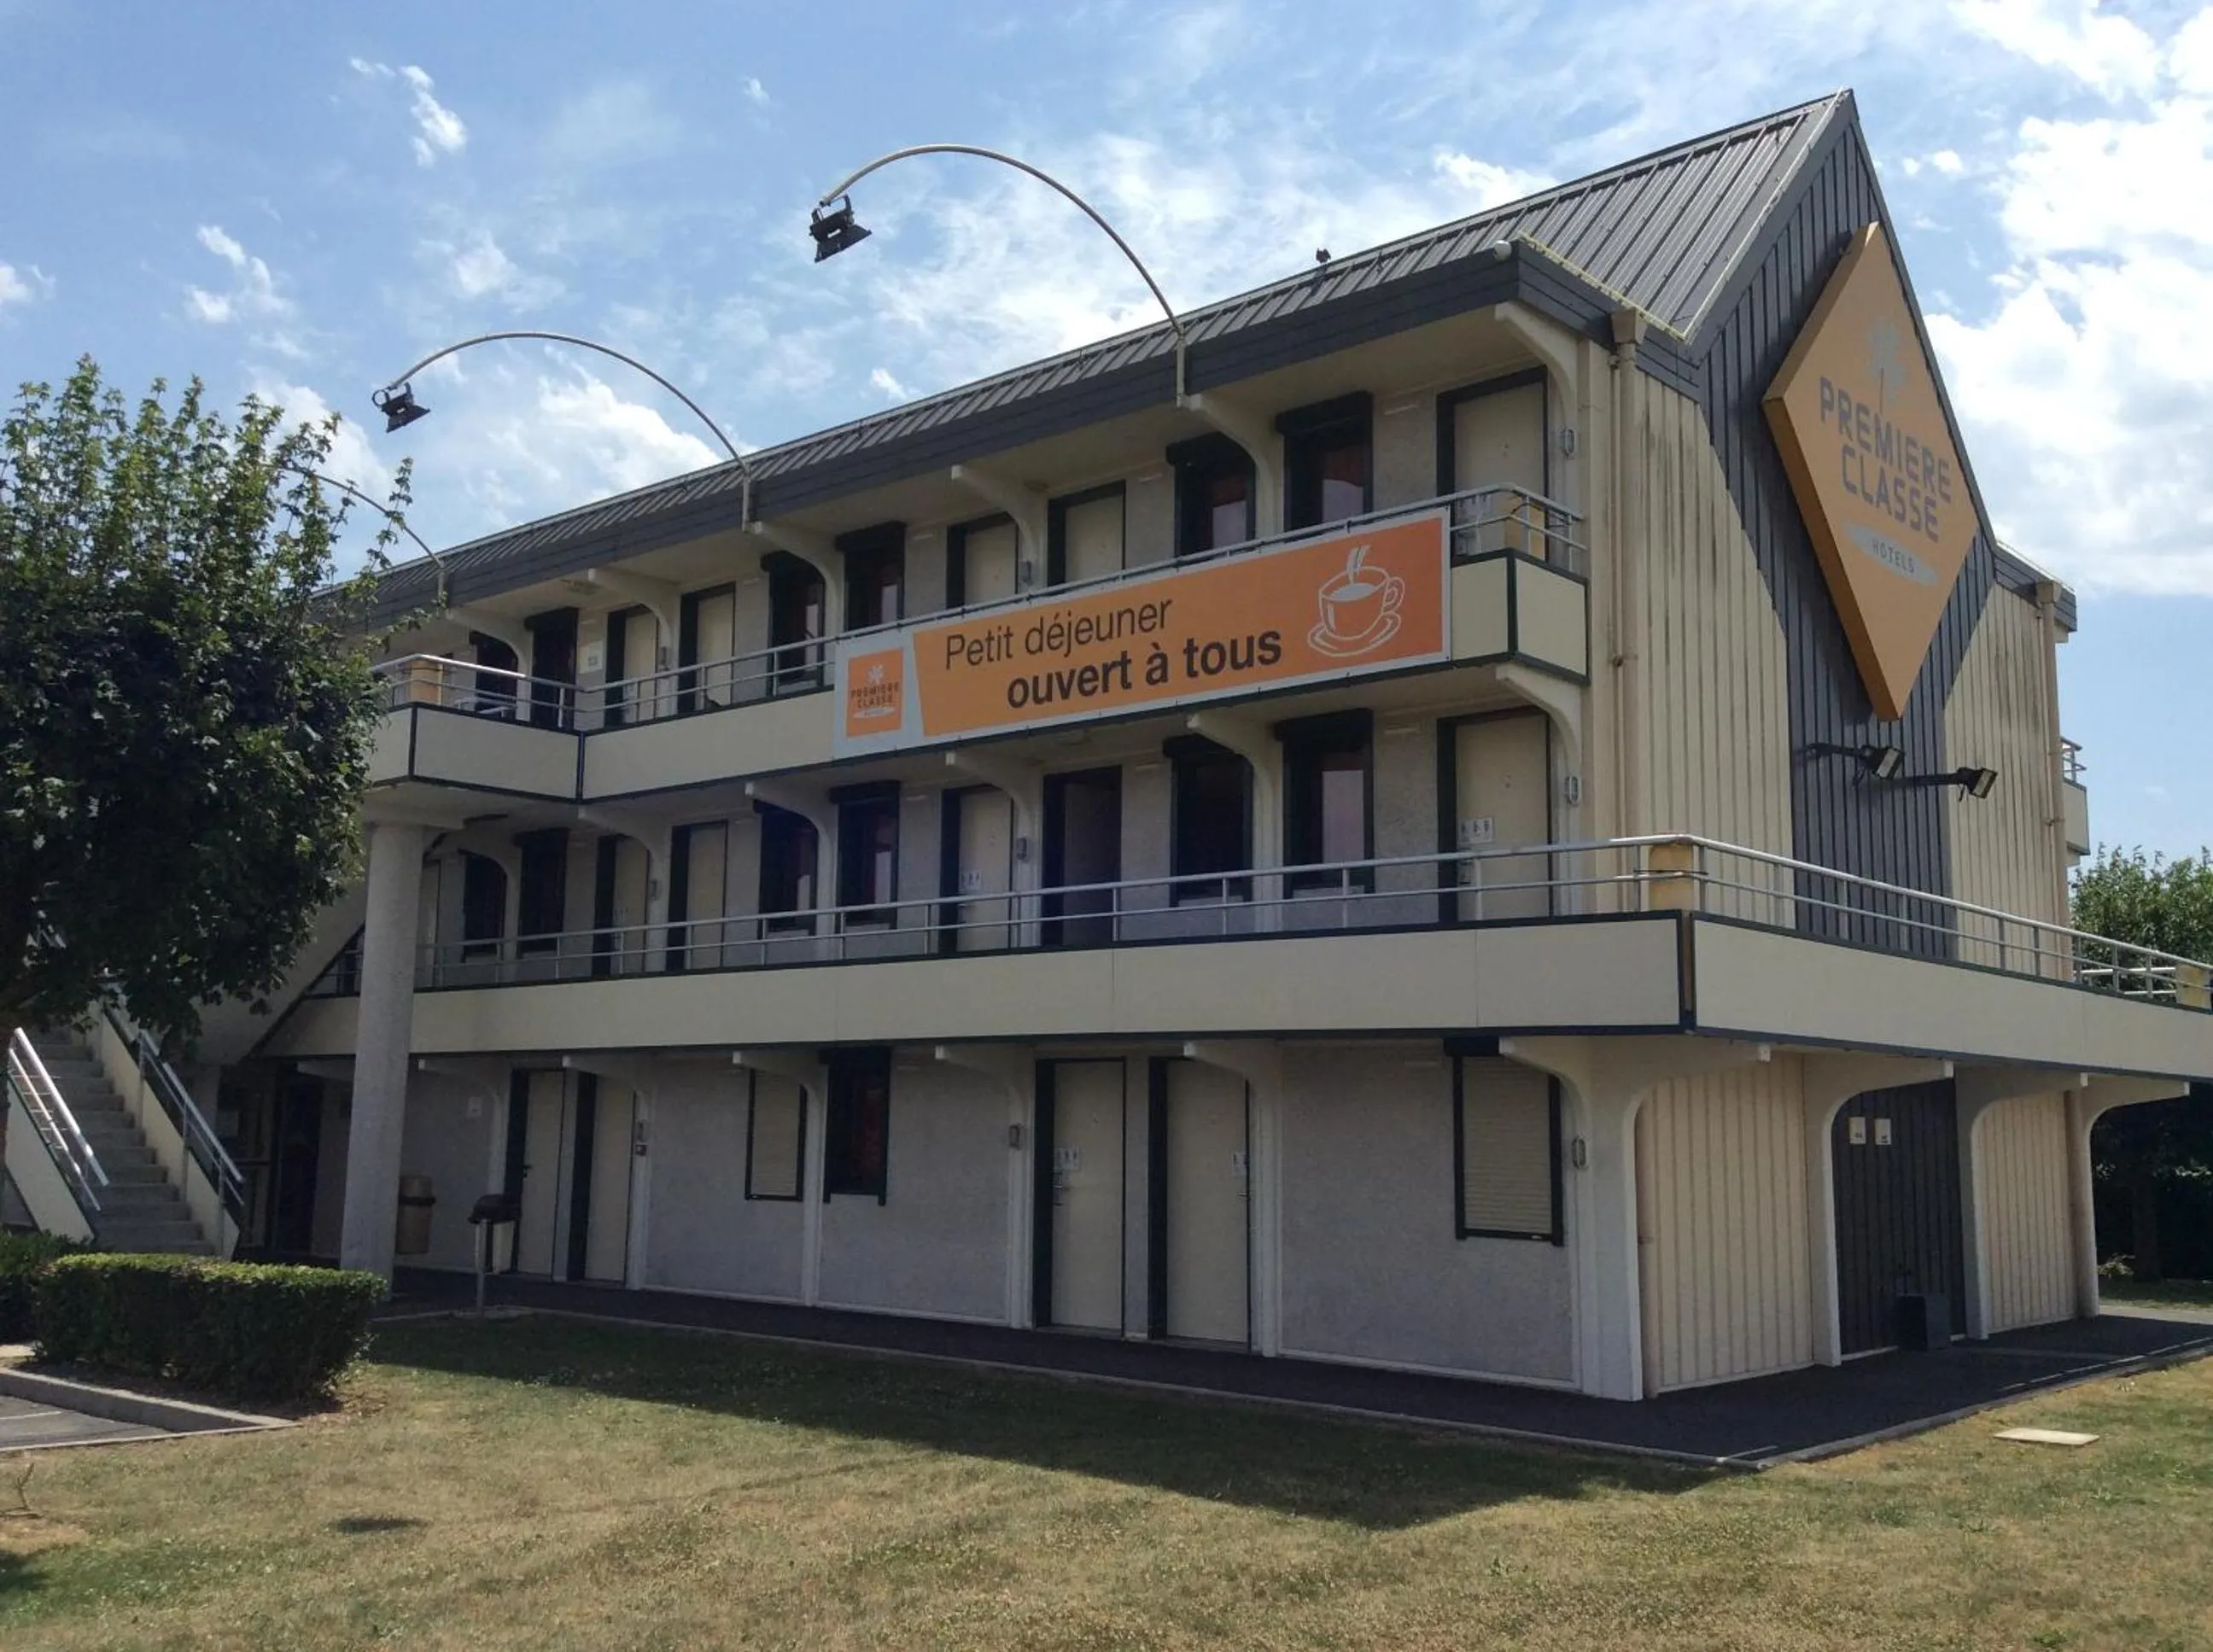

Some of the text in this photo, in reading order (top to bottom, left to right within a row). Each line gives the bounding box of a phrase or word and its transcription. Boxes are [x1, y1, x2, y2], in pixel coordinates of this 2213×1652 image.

[1819, 376, 1952, 505] PREMIERE
[1841, 443, 1940, 544] CLASSE
[1872, 538, 1915, 575] HOTELS
[944, 599, 1173, 670] Petit déjeuner
[1007, 630, 1282, 708] ouvert à tous
